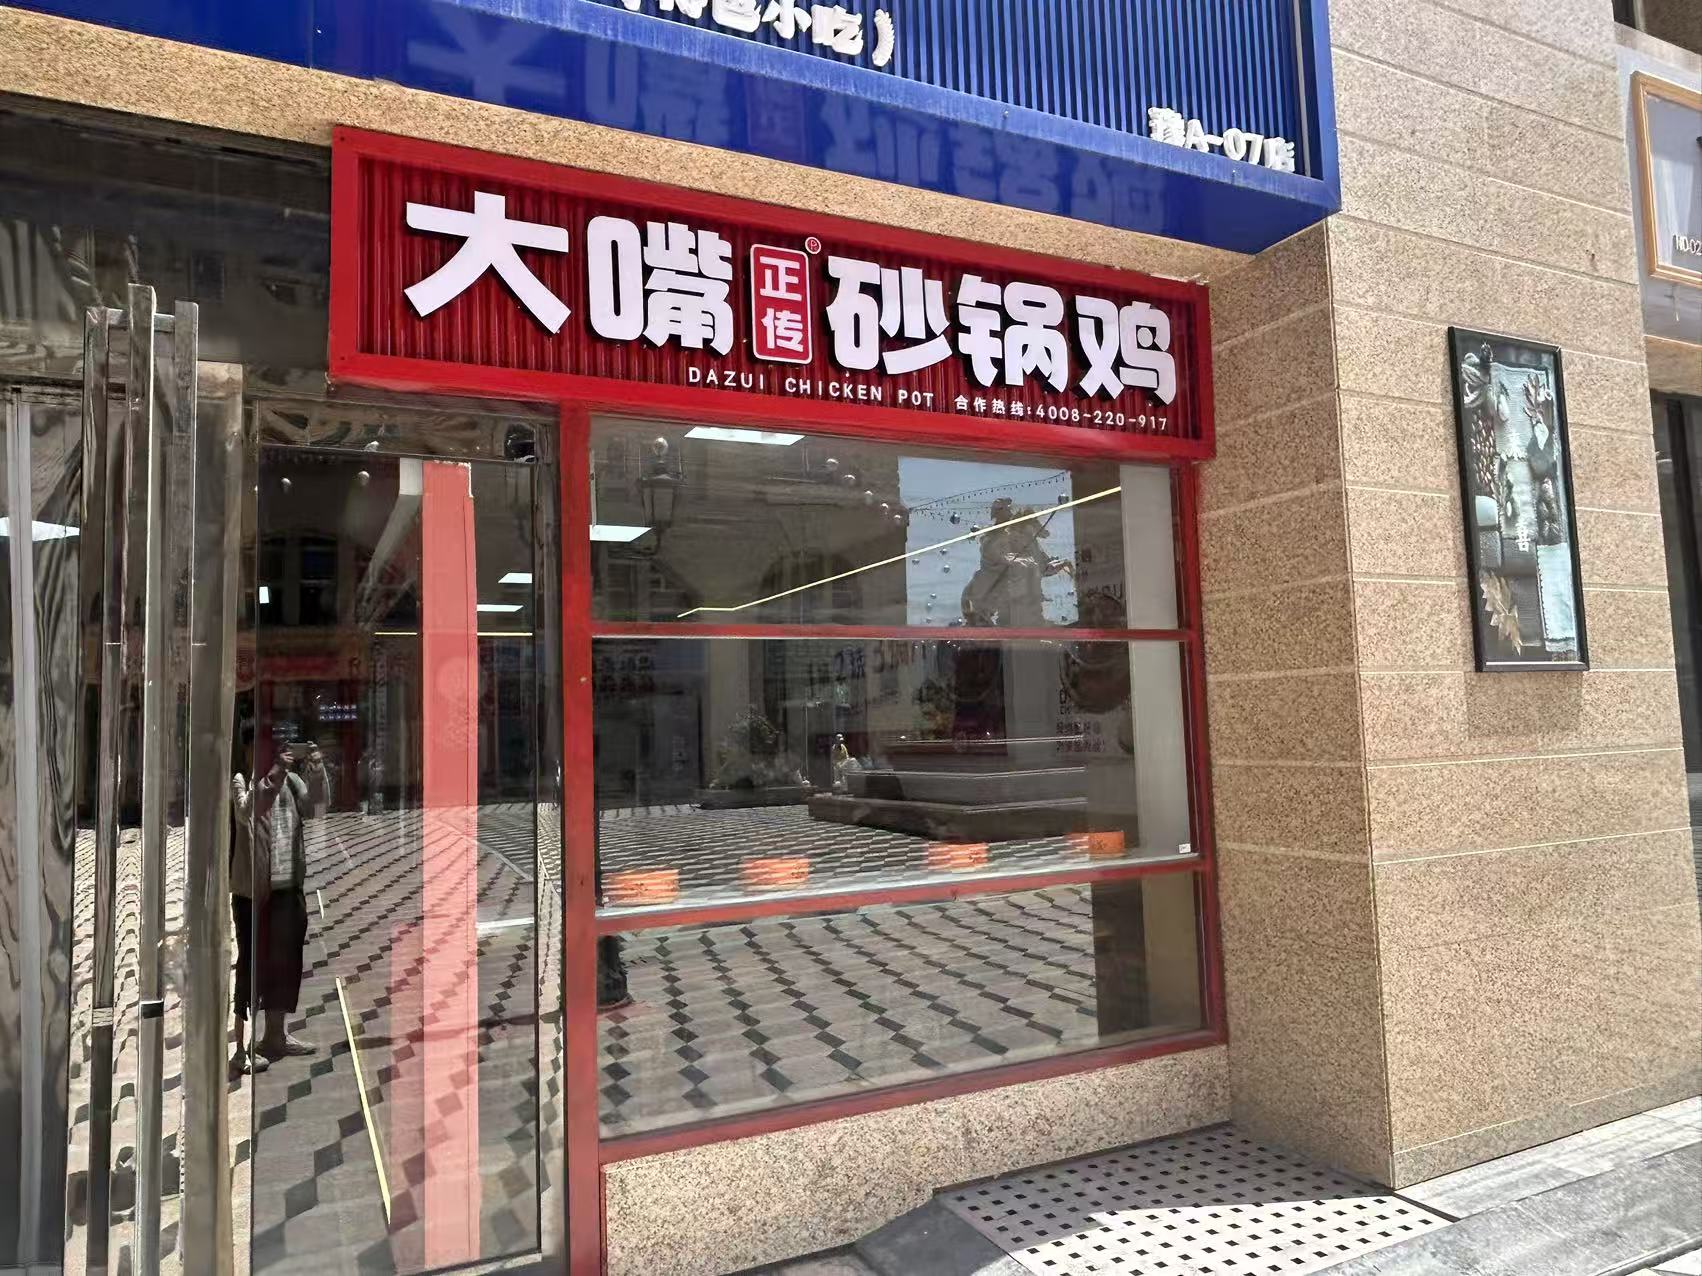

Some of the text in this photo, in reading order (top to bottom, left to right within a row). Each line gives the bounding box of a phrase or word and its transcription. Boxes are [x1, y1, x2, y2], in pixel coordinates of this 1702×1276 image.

[759, 255, 805, 353] 正传
[825, 255, 1177, 406] 砂锅鸡
[688, 366, 934, 408] DAZUI CHICKEN POT
